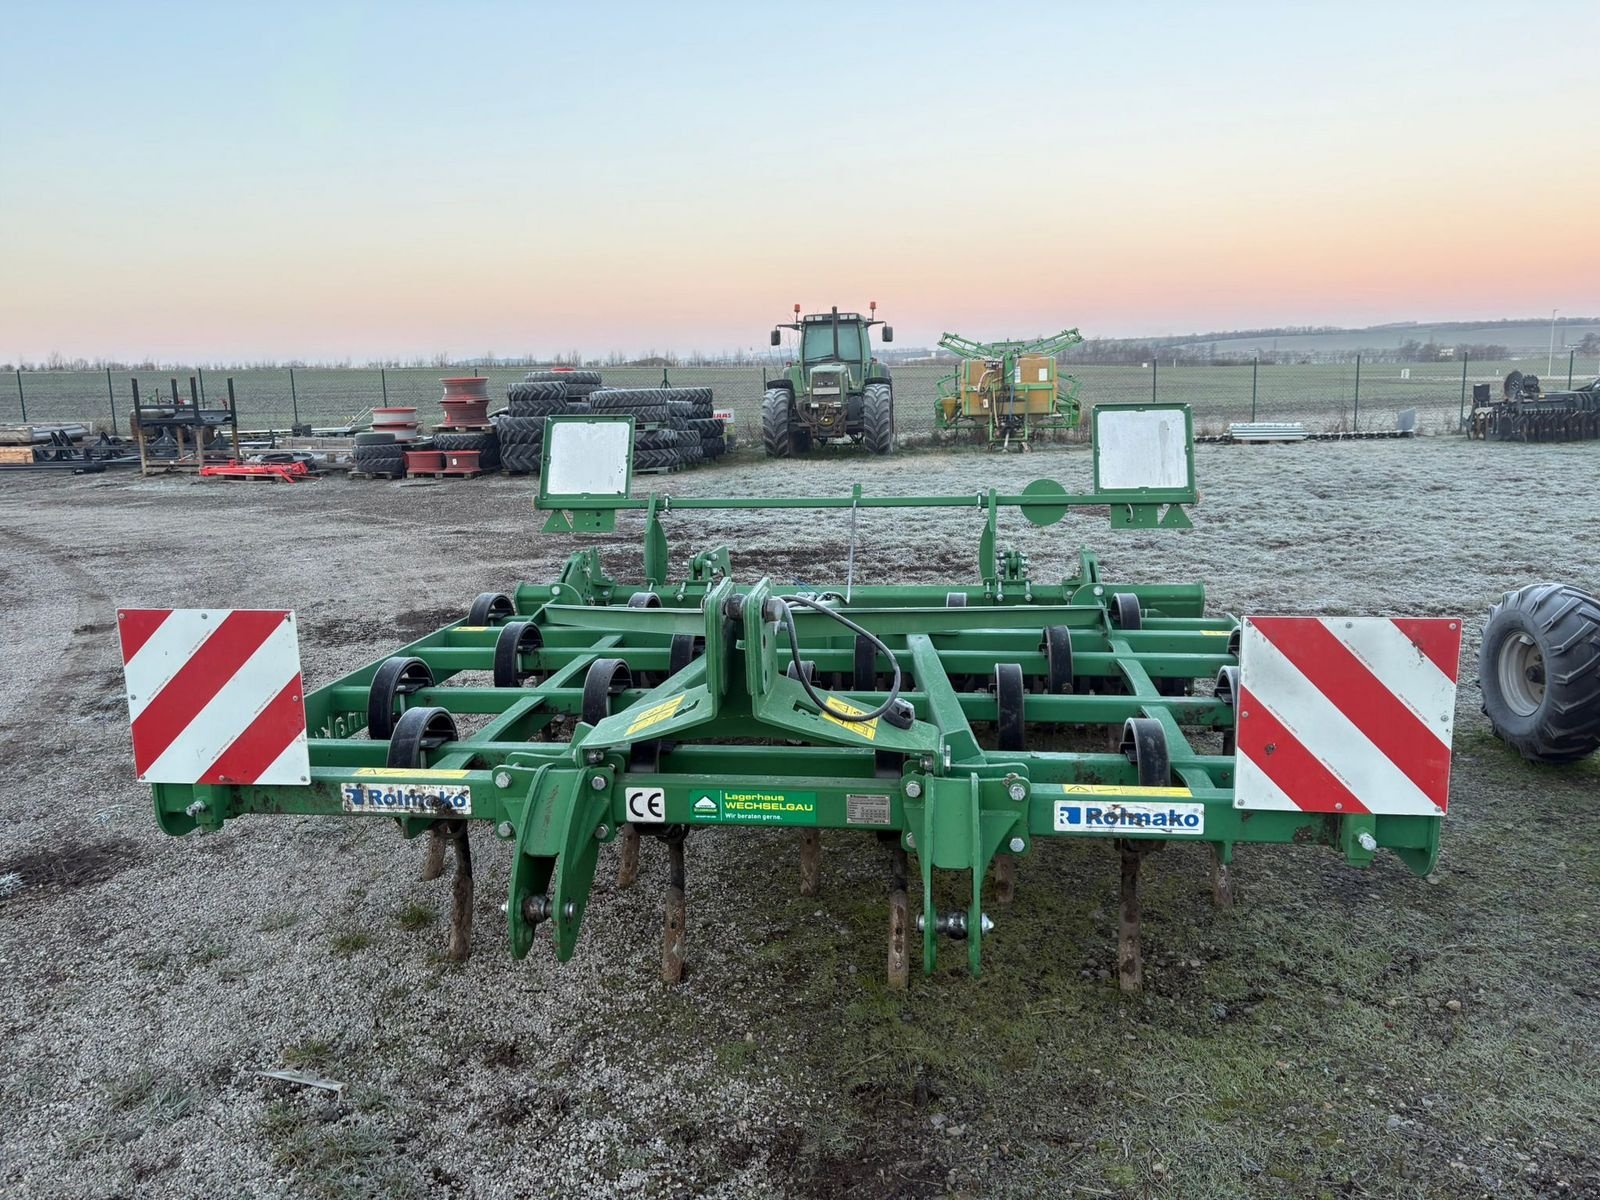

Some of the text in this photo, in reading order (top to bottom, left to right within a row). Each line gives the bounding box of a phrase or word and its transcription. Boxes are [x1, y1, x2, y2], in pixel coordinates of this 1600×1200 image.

[725, 792, 785, 802] Lagerhaus
[629, 792, 662, 818] CE
[725, 802, 813, 811] WECHSELGAU
[1086, 806, 1200, 827] Rolmako
